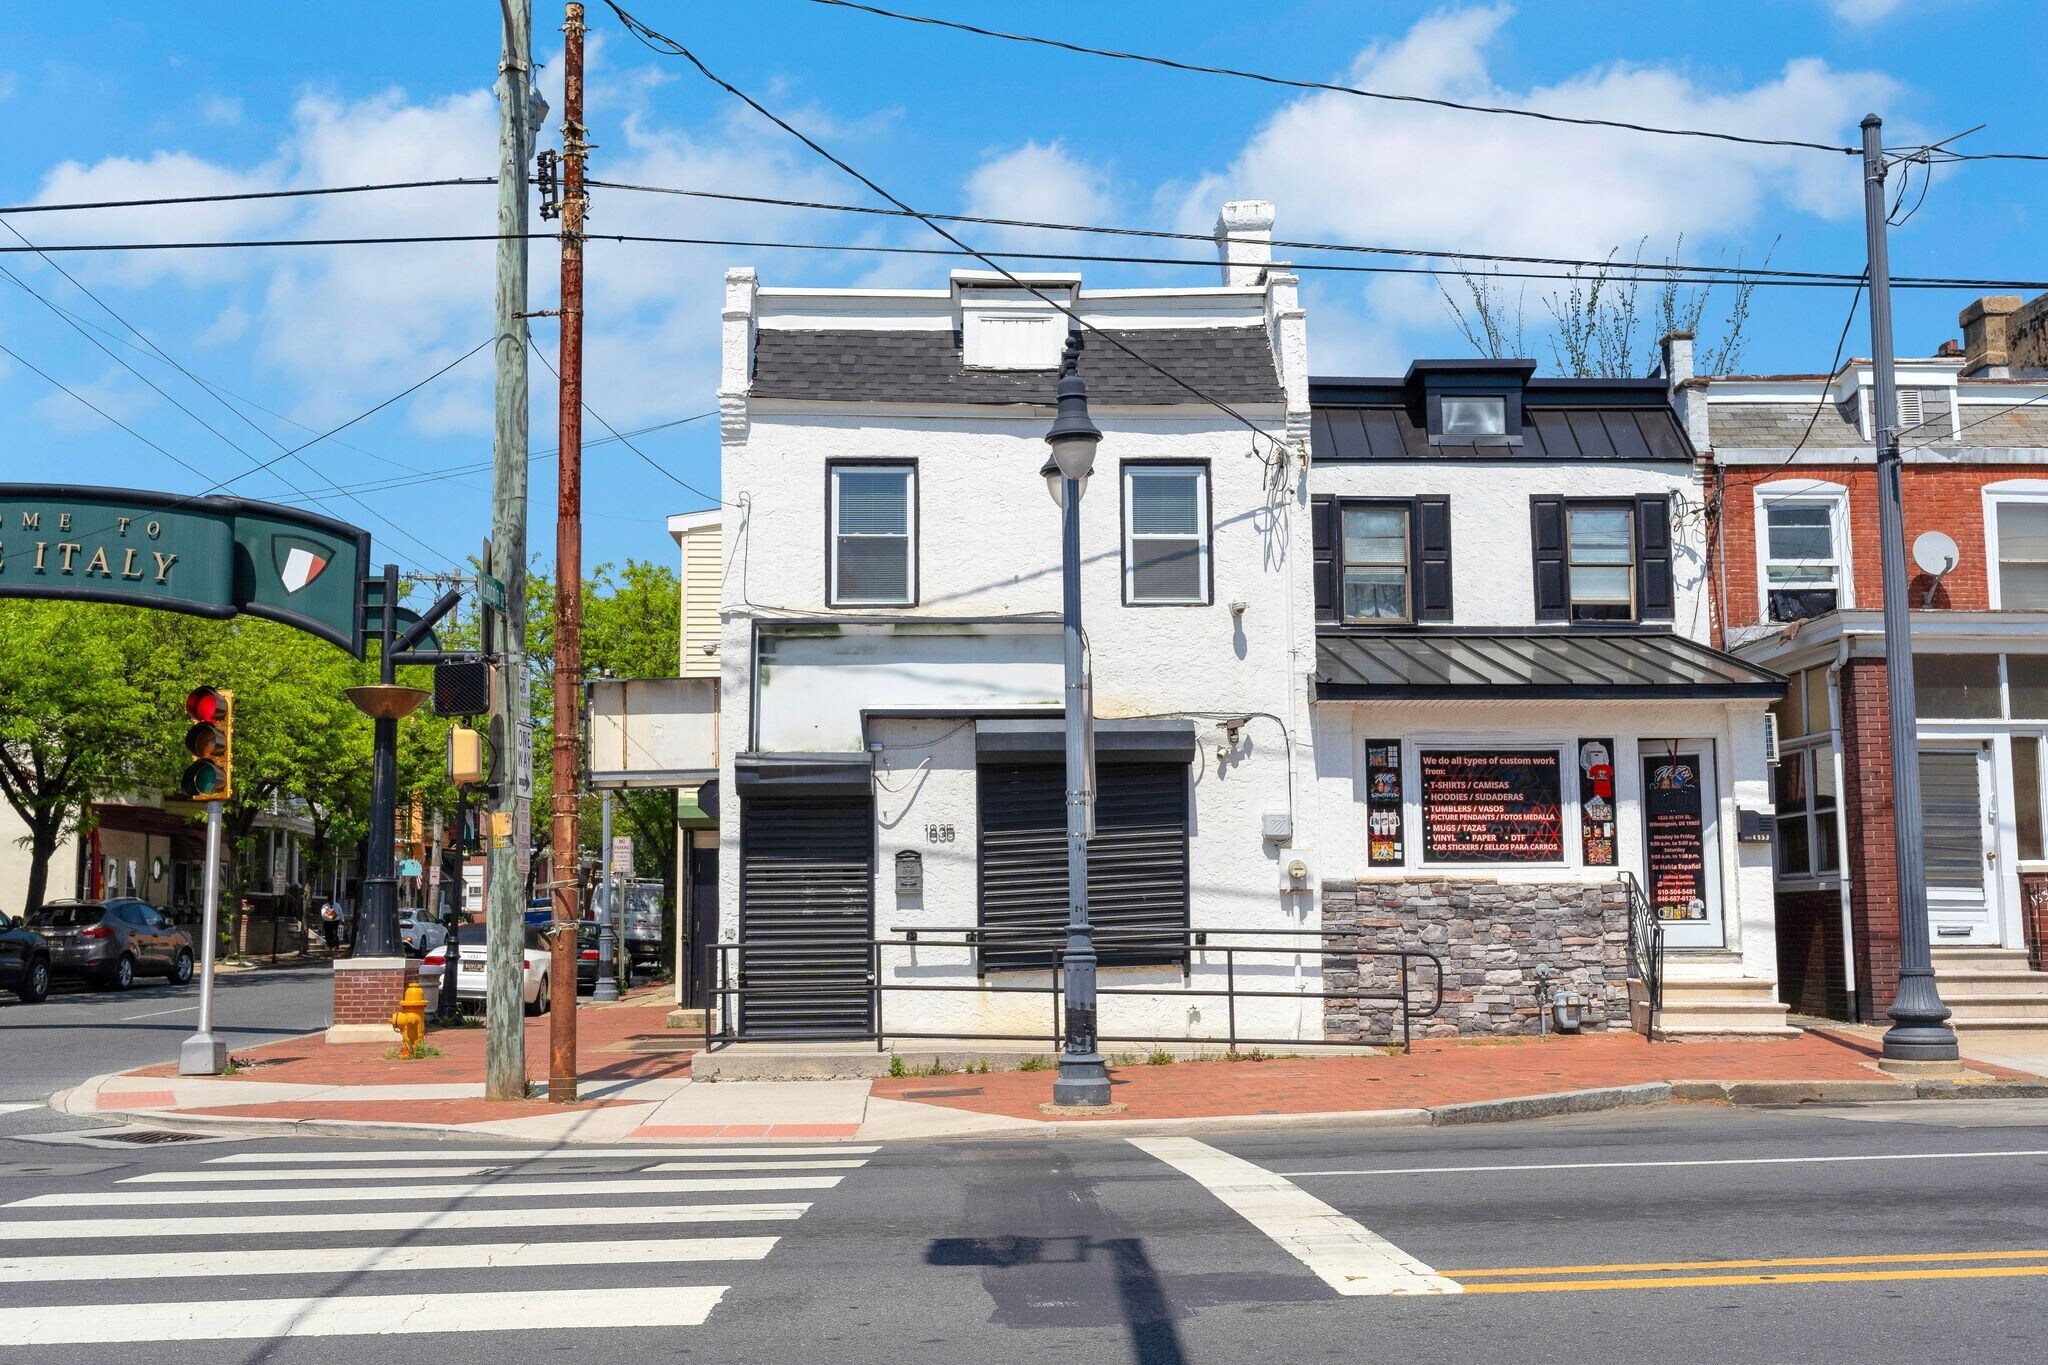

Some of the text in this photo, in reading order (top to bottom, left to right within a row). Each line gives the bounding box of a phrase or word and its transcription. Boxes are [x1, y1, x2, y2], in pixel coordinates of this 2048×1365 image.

[0, 511, 161, 536] ME TO
[33, 541, 177, 580] ITALY
[518, 728, 531, 749] ONE
[518, 750, 531, 769] WAY
[1422, 757, 1436, 765] We
[1438, 757, 1450, 765] do
[1451, 757, 1462, 765] all
[1464, 757, 1487, 767] types
[1488, 757, 1498, 765] of
[1533, 756, 1555, 764] work
[924, 823, 955, 844] 1835
